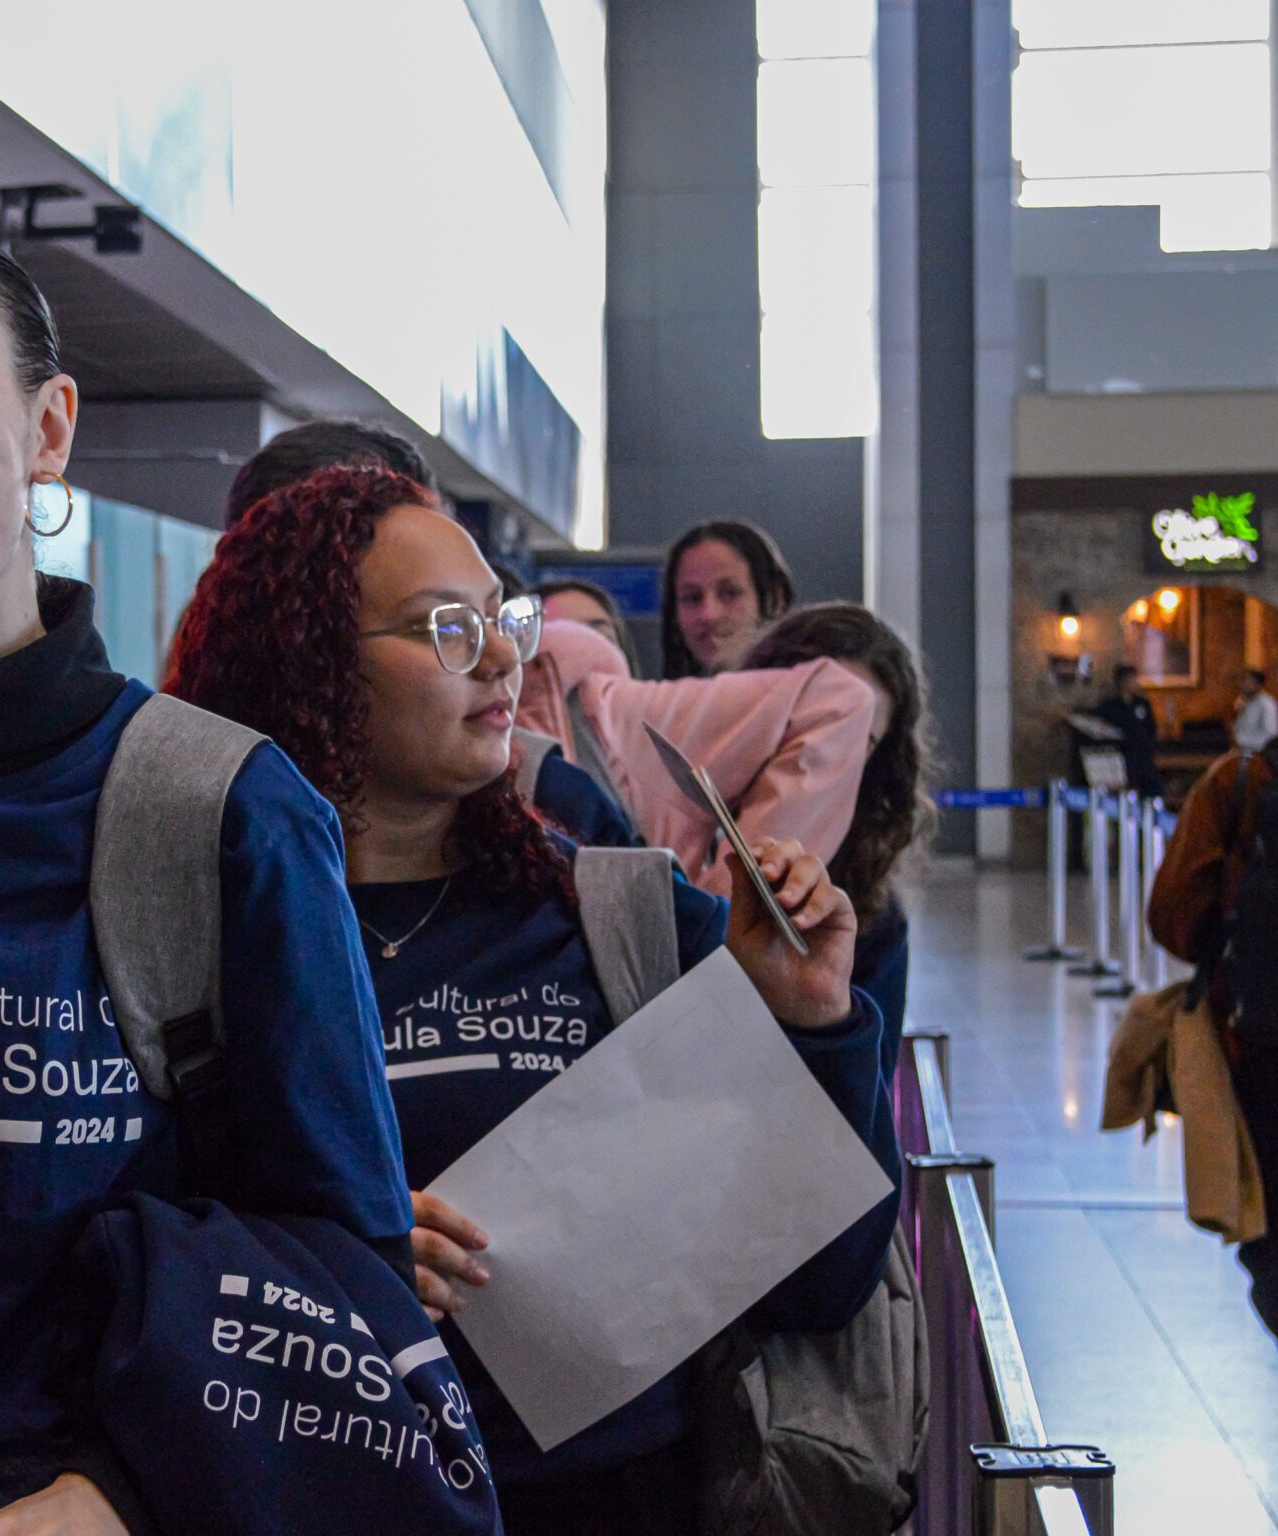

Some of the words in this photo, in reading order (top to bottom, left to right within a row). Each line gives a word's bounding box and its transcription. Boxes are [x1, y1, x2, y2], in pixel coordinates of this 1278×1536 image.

[395, 983, 529, 1016] ultural
[541, 981, 581, 1007] do
[456, 1015, 588, 1047] Souza
[2, 1043, 139, 1096] Souza
[509, 1051, 566, 1073] 2024
[54, 1116, 115, 1145] 2024
[263, 1281, 336, 1324] 2024
[211, 1317, 393, 1402] Souza
[203, 1379, 262, 1429] do
[278, 1399, 450, 1488] ultural
